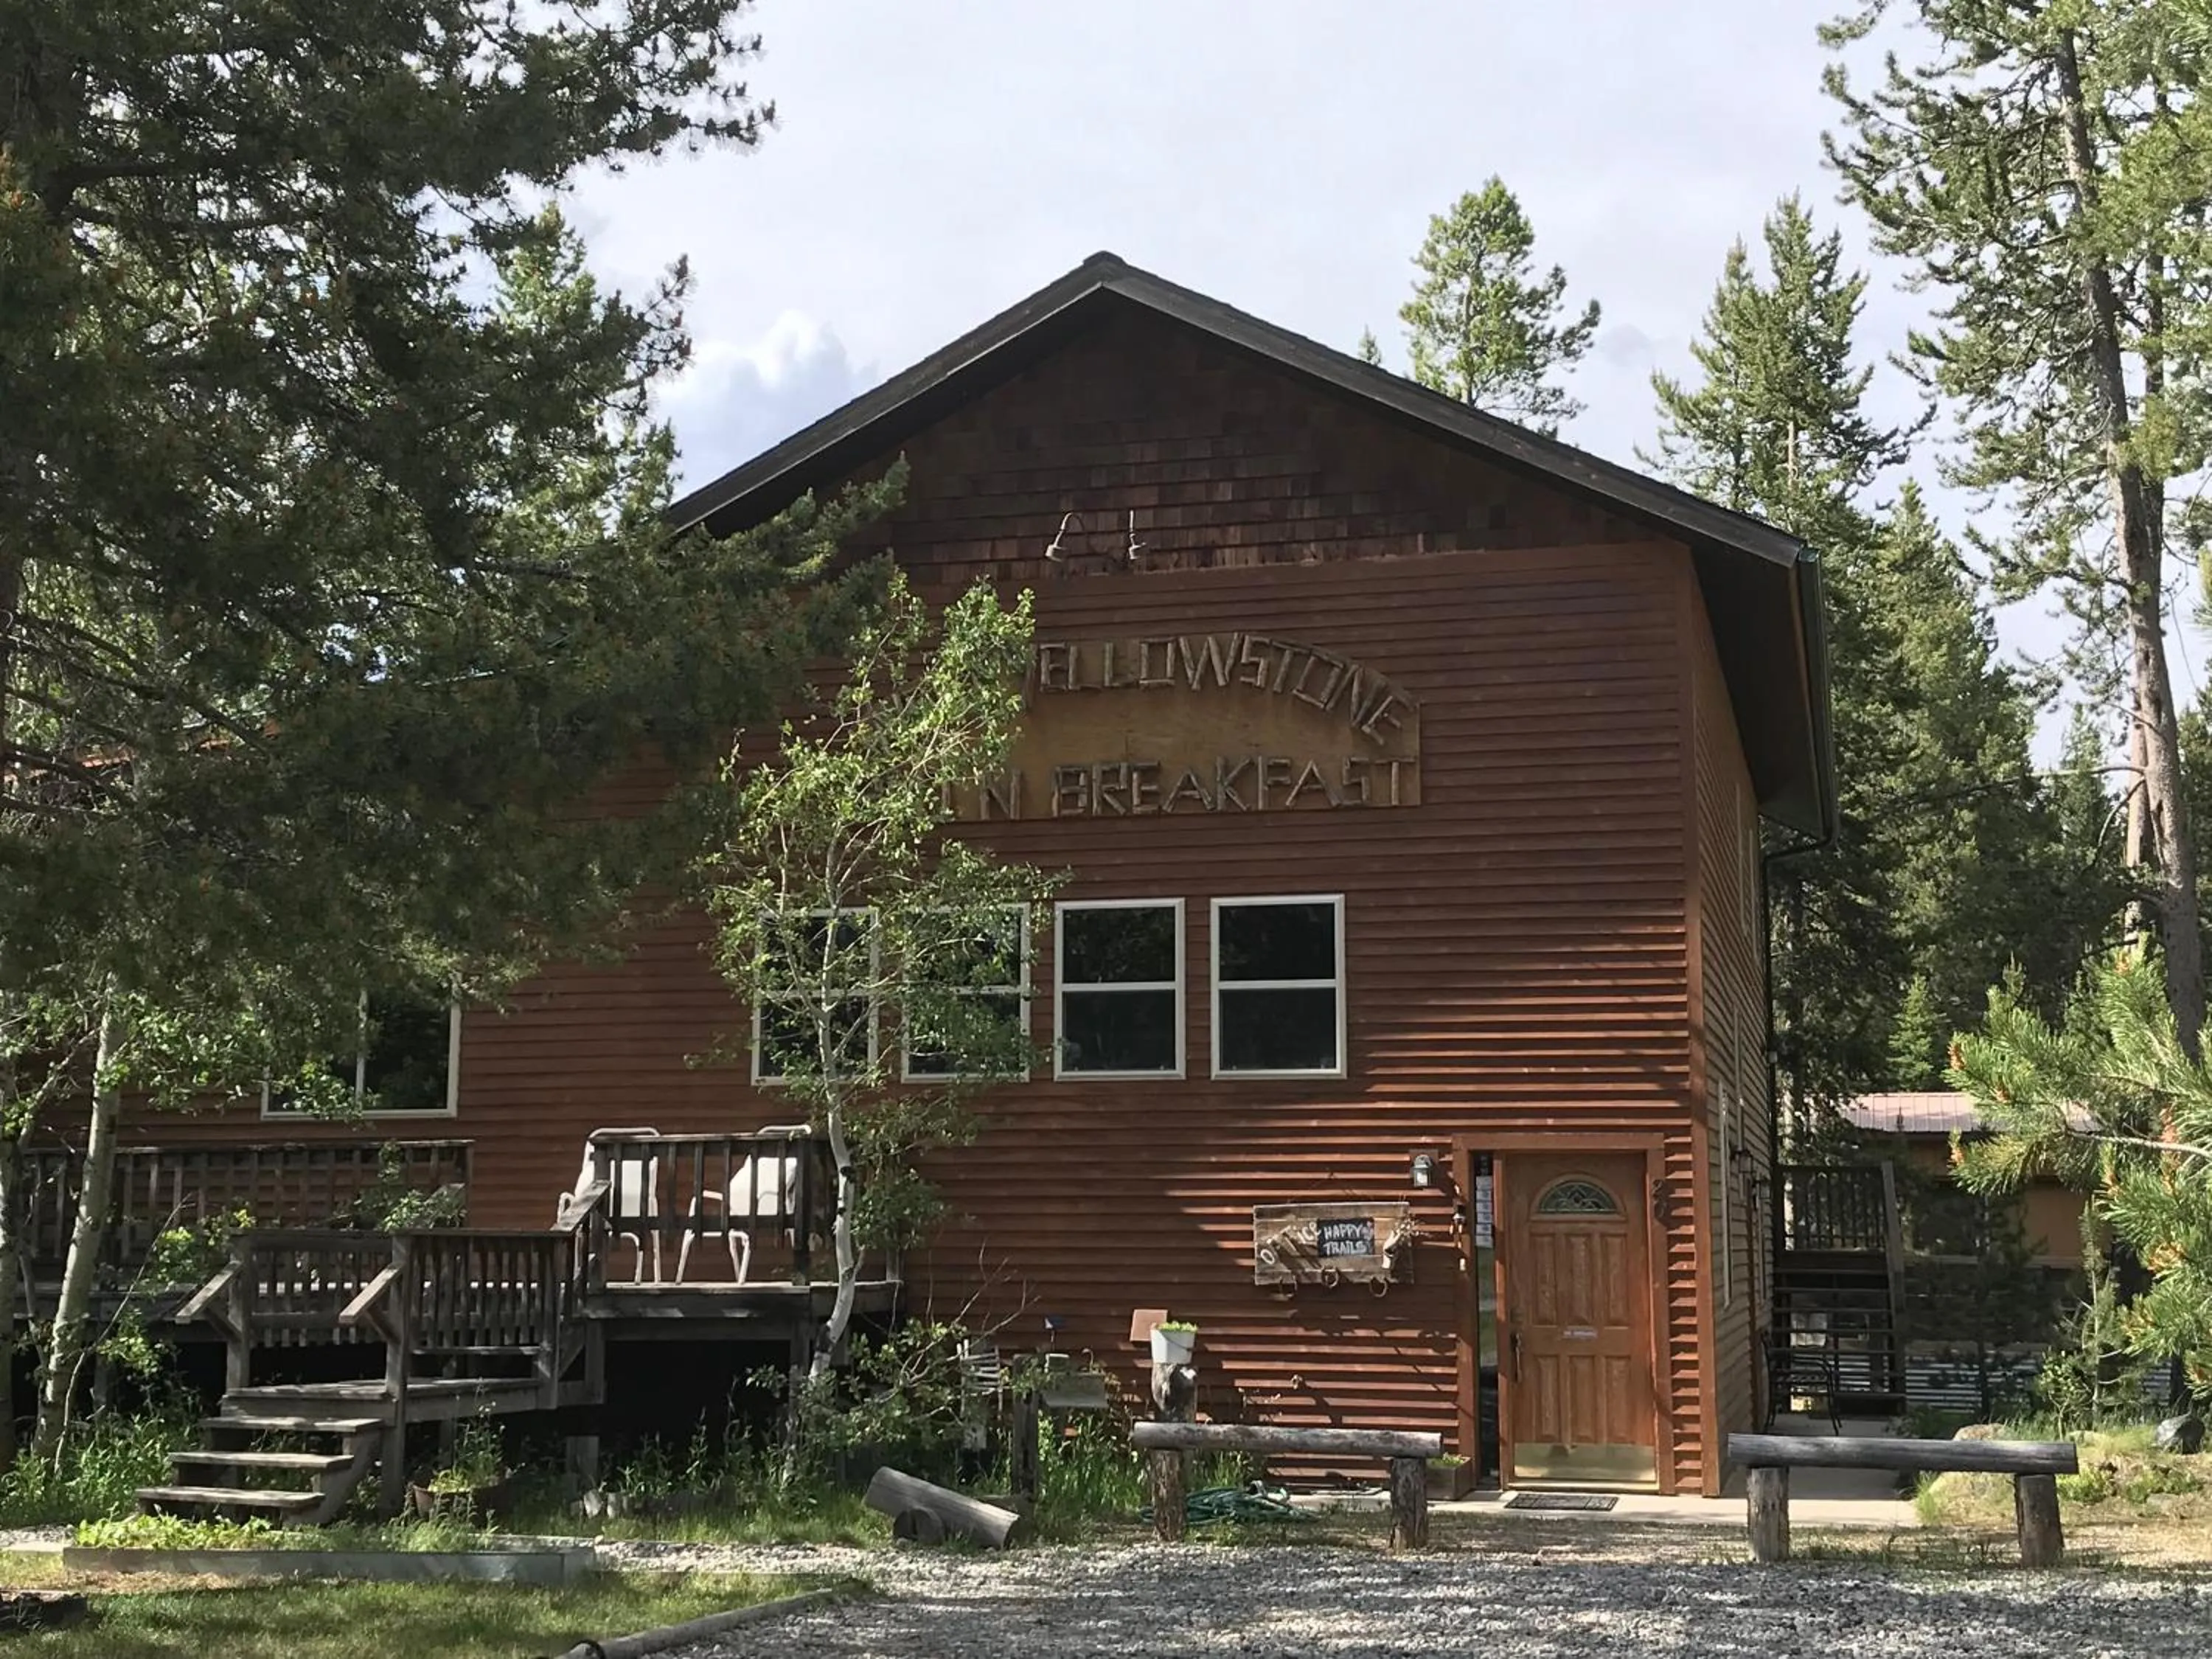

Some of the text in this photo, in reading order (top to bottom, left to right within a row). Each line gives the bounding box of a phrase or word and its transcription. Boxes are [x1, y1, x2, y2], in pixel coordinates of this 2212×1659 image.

[1022, 632, 1413, 745] ELLOWSTONE
[1052, 756, 1416, 817] BREAKFAST
[1324, 1223, 1363, 1240] HAPPY
